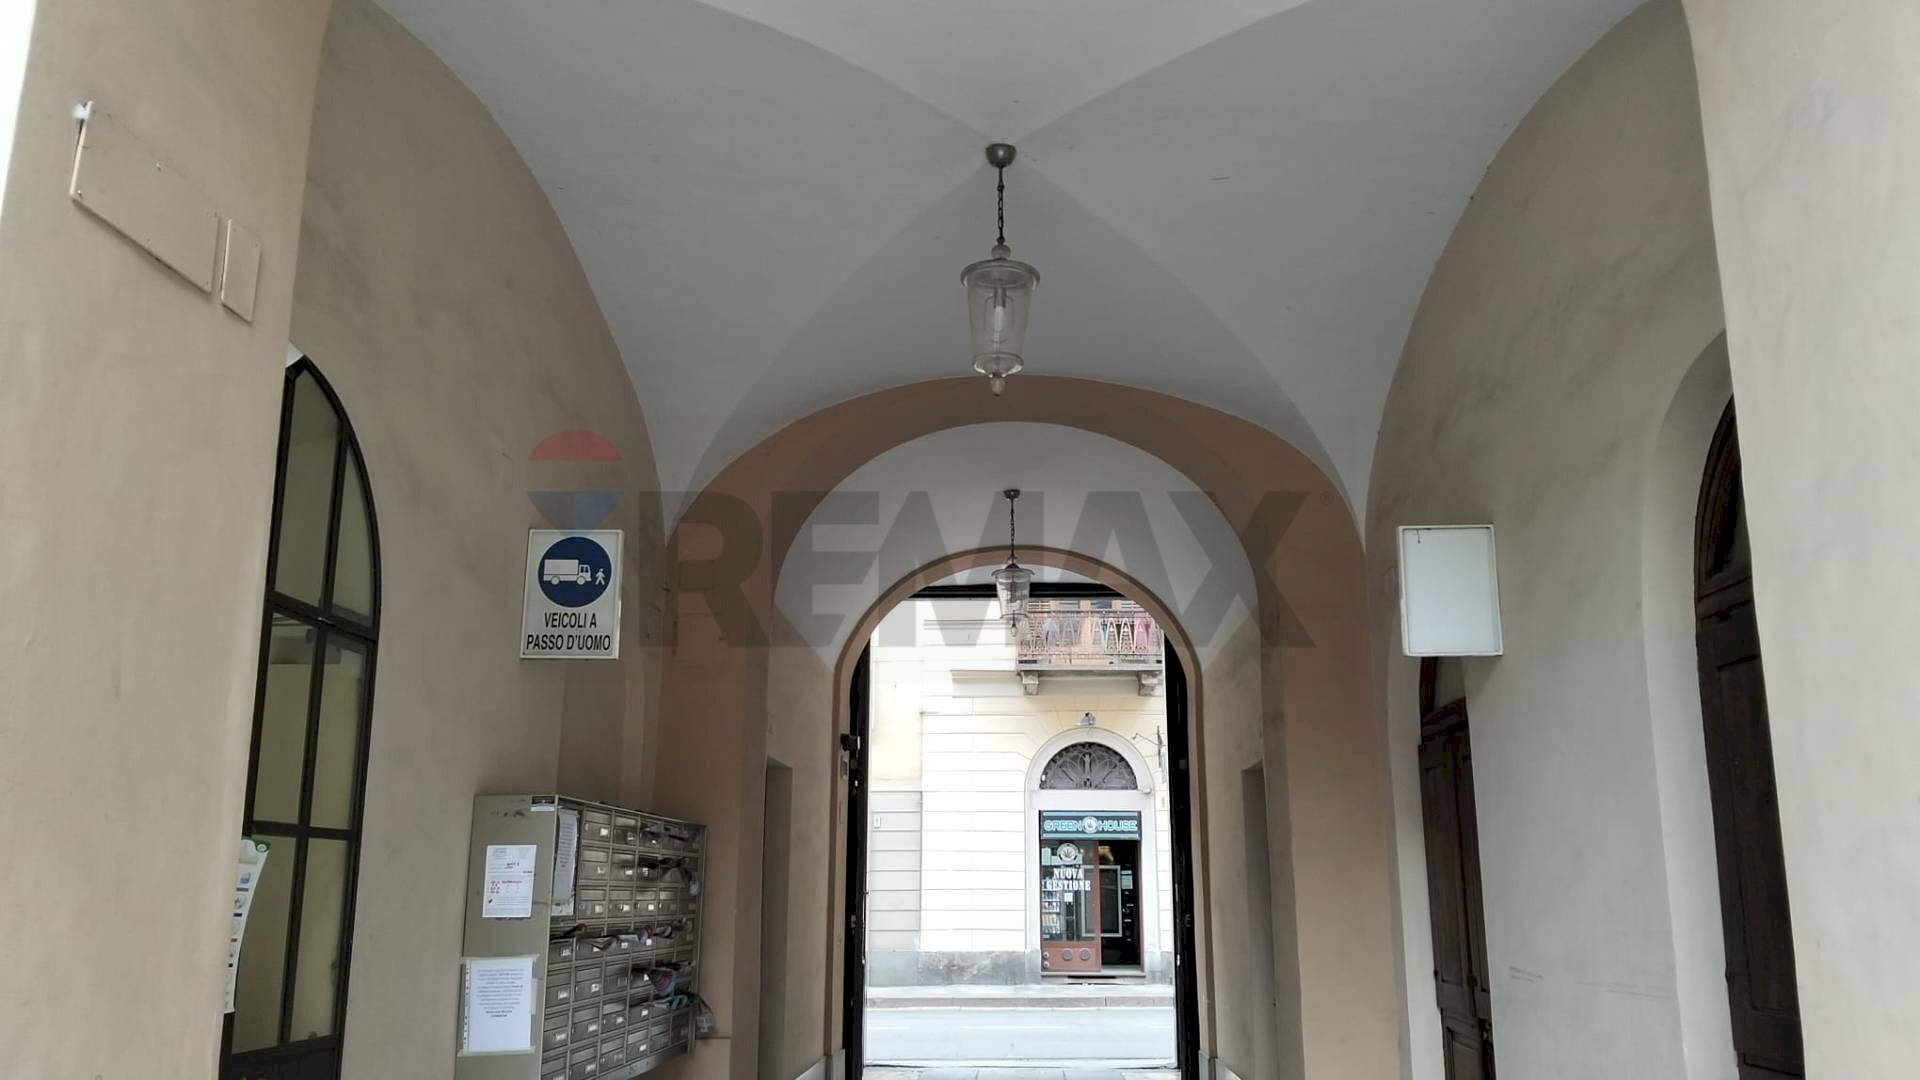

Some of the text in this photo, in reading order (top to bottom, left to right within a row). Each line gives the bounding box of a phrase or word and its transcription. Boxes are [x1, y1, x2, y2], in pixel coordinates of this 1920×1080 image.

[544, 612, 597, 628] VEICOLI A
[526, 634, 611, 651] PASSO D'UOMO
[1043, 820, 1138, 831] GREEN HOUSE
[1053, 868, 1084, 879] NUOVA
[1046, 880, 1091, 891] GESTIONE
